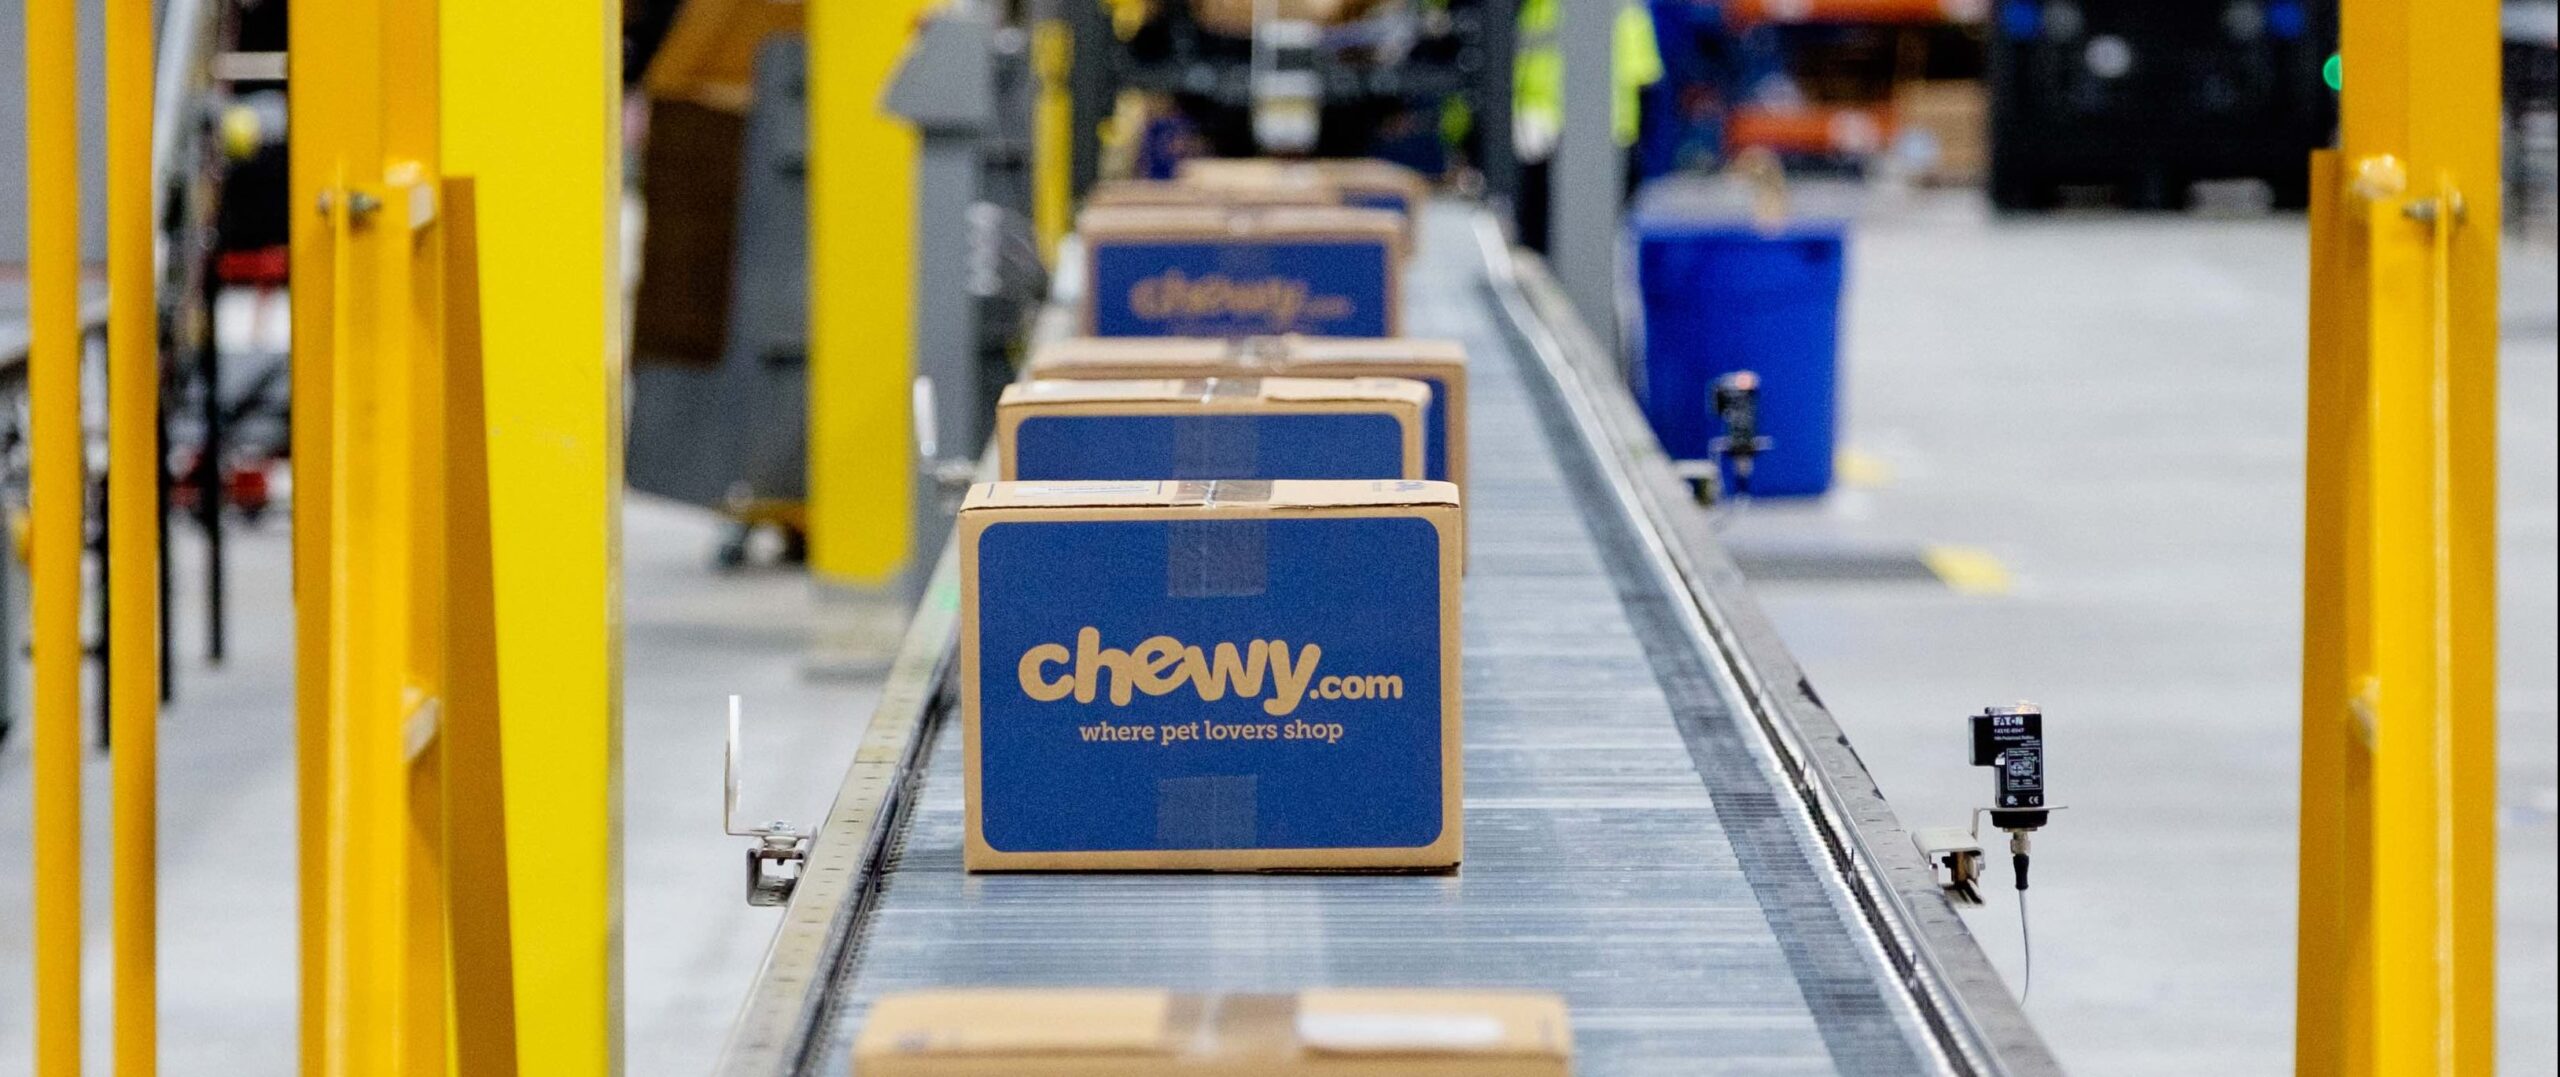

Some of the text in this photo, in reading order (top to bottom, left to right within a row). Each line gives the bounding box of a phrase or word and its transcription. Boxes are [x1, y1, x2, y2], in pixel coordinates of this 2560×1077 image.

[1018, 626, 1403, 716] chewy.com
[1079, 719, 1343, 746] where pet lovers shop
